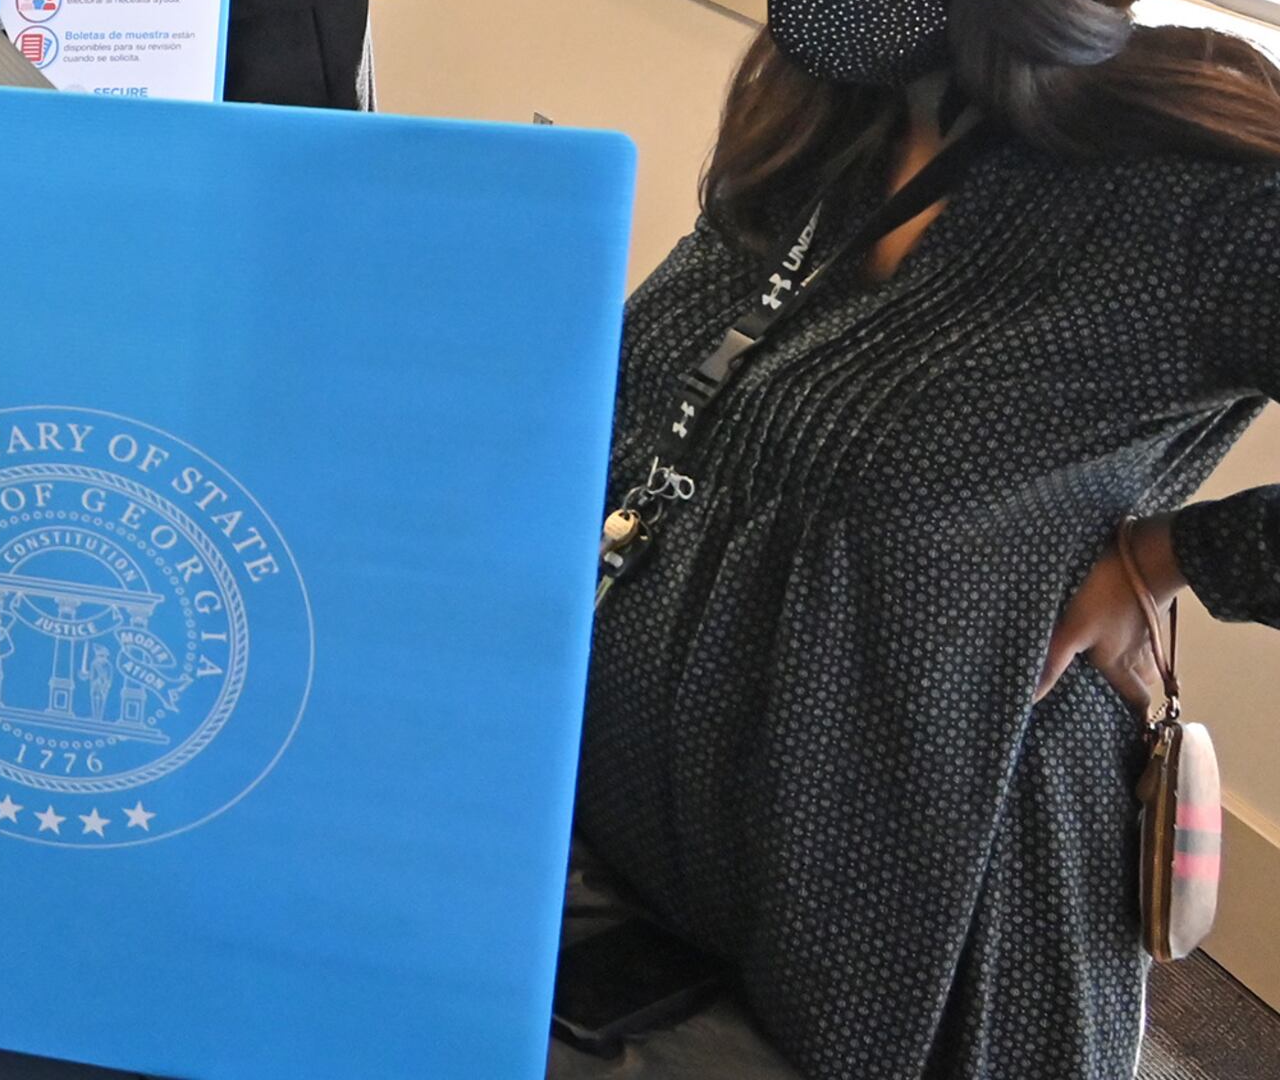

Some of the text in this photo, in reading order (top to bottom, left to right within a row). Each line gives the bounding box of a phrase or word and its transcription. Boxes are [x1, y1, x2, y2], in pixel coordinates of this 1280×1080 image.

[64, 44, 111, 52] disponibles
[148, 42, 181, 50] revisión
[65, 31, 169, 40] Boletas de muestra
[107, 433, 170, 474] OF
[171, 466, 281, 584] STATE
[3, 530, 137, 584] CONSTITUTION
[0, 483, 54, 513] OF
[81, 488, 227, 679] GEORGIA
[34, 617, 97, 636] JUSTICE
[15, 742, 104, 774] 1776
